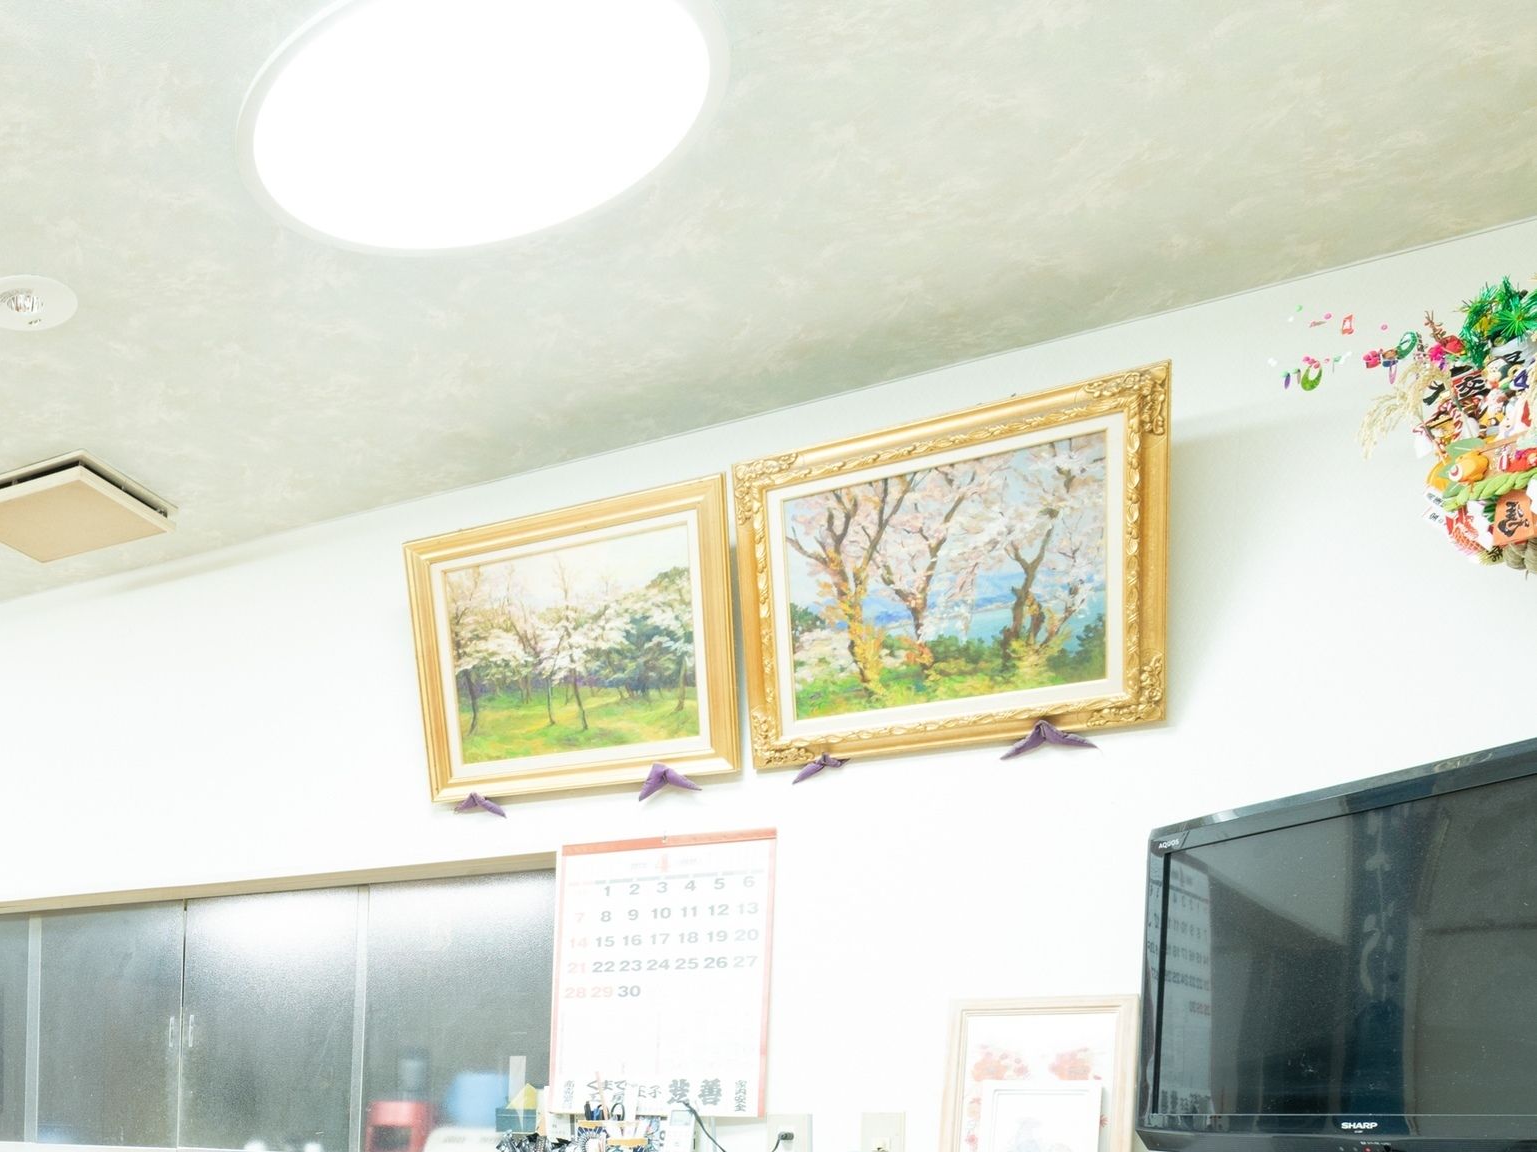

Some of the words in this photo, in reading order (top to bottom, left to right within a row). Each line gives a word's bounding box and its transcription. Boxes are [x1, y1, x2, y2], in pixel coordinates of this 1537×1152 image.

[603, 886, 611, 897] 1
[629, 884, 640, 895] 2
[656, 882, 668, 893] 3
[684, 880, 697, 891] 4
[714, 878, 725, 890] 5
[743, 876, 755, 887] 6
[575, 912, 585, 923] 7
[600, 911, 612, 922] 8
[627, 909, 639, 921] 9
[651, 907, 671, 919] 10
[680, 905, 698, 917] 11
[708, 904, 729, 916] 12
[737, 902, 759, 914] 13
[570, 937, 588, 948] 14
[596, 936, 615, 947] 15
[623, 934, 642, 946] 16
[650, 933, 670, 944] 17
[679, 932, 699, 943] 18
[707, 930, 728, 942] 19
[735, 928, 759, 941] 20
[568, 962, 586, 974] 21
[592, 961, 615, 973] 22
[619, 960, 642, 972] 23
[646, 959, 670, 971] 24
[674, 958, 699, 970] 25
[703, 956, 728, 969] 26
[733, 955, 758, 967] 27
[565, 987, 586, 998] 28
[591, 986, 613, 998] 29
[617, 985, 641, 998] 30
[1341, 1122, 1378, 1130] SHARP
